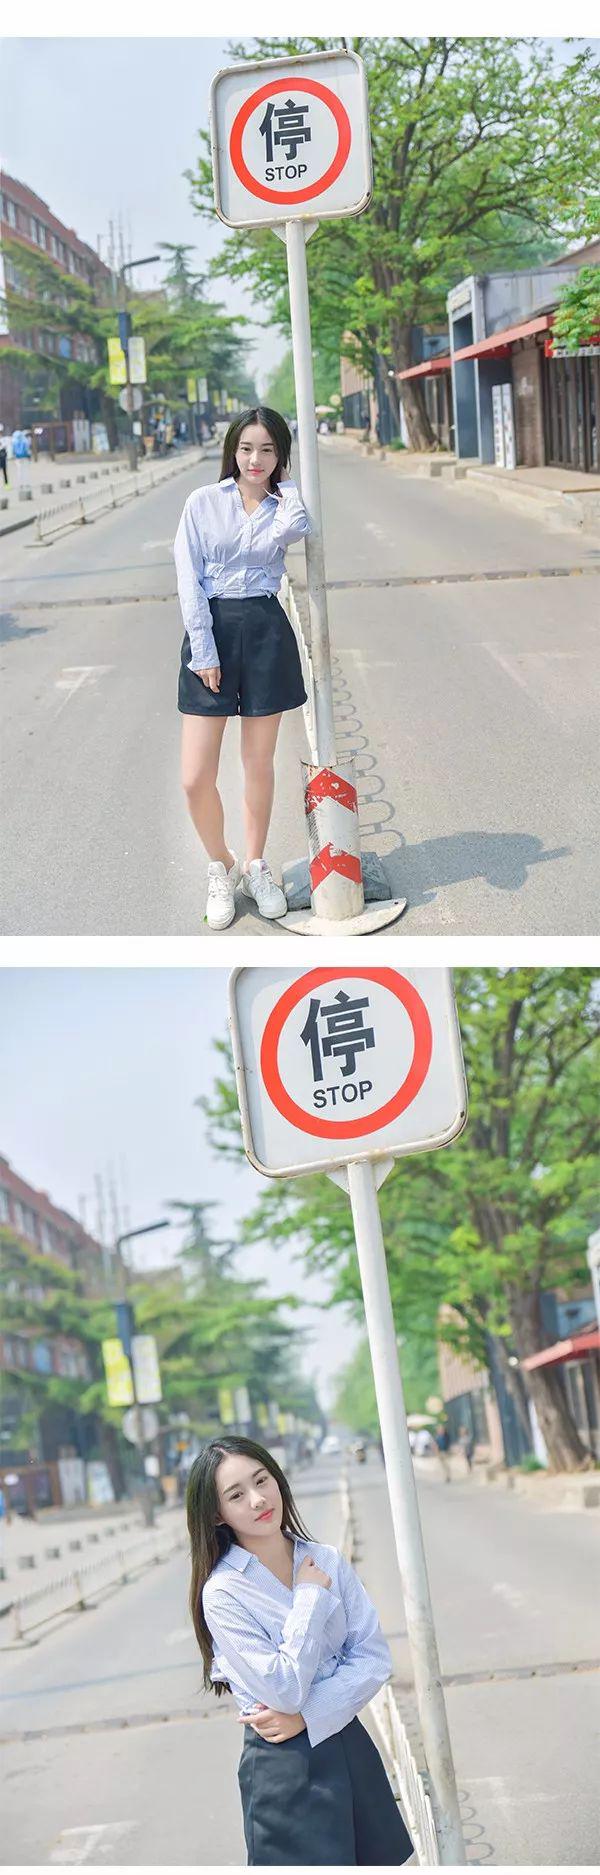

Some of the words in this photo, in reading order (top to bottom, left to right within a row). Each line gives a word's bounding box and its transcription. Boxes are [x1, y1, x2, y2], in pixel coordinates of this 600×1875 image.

[259, 99, 311, 162] 停
[265, 165, 307, 181] STOP
[300, 990, 375, 1082] 停
[313, 1080, 373, 1108] STOP
